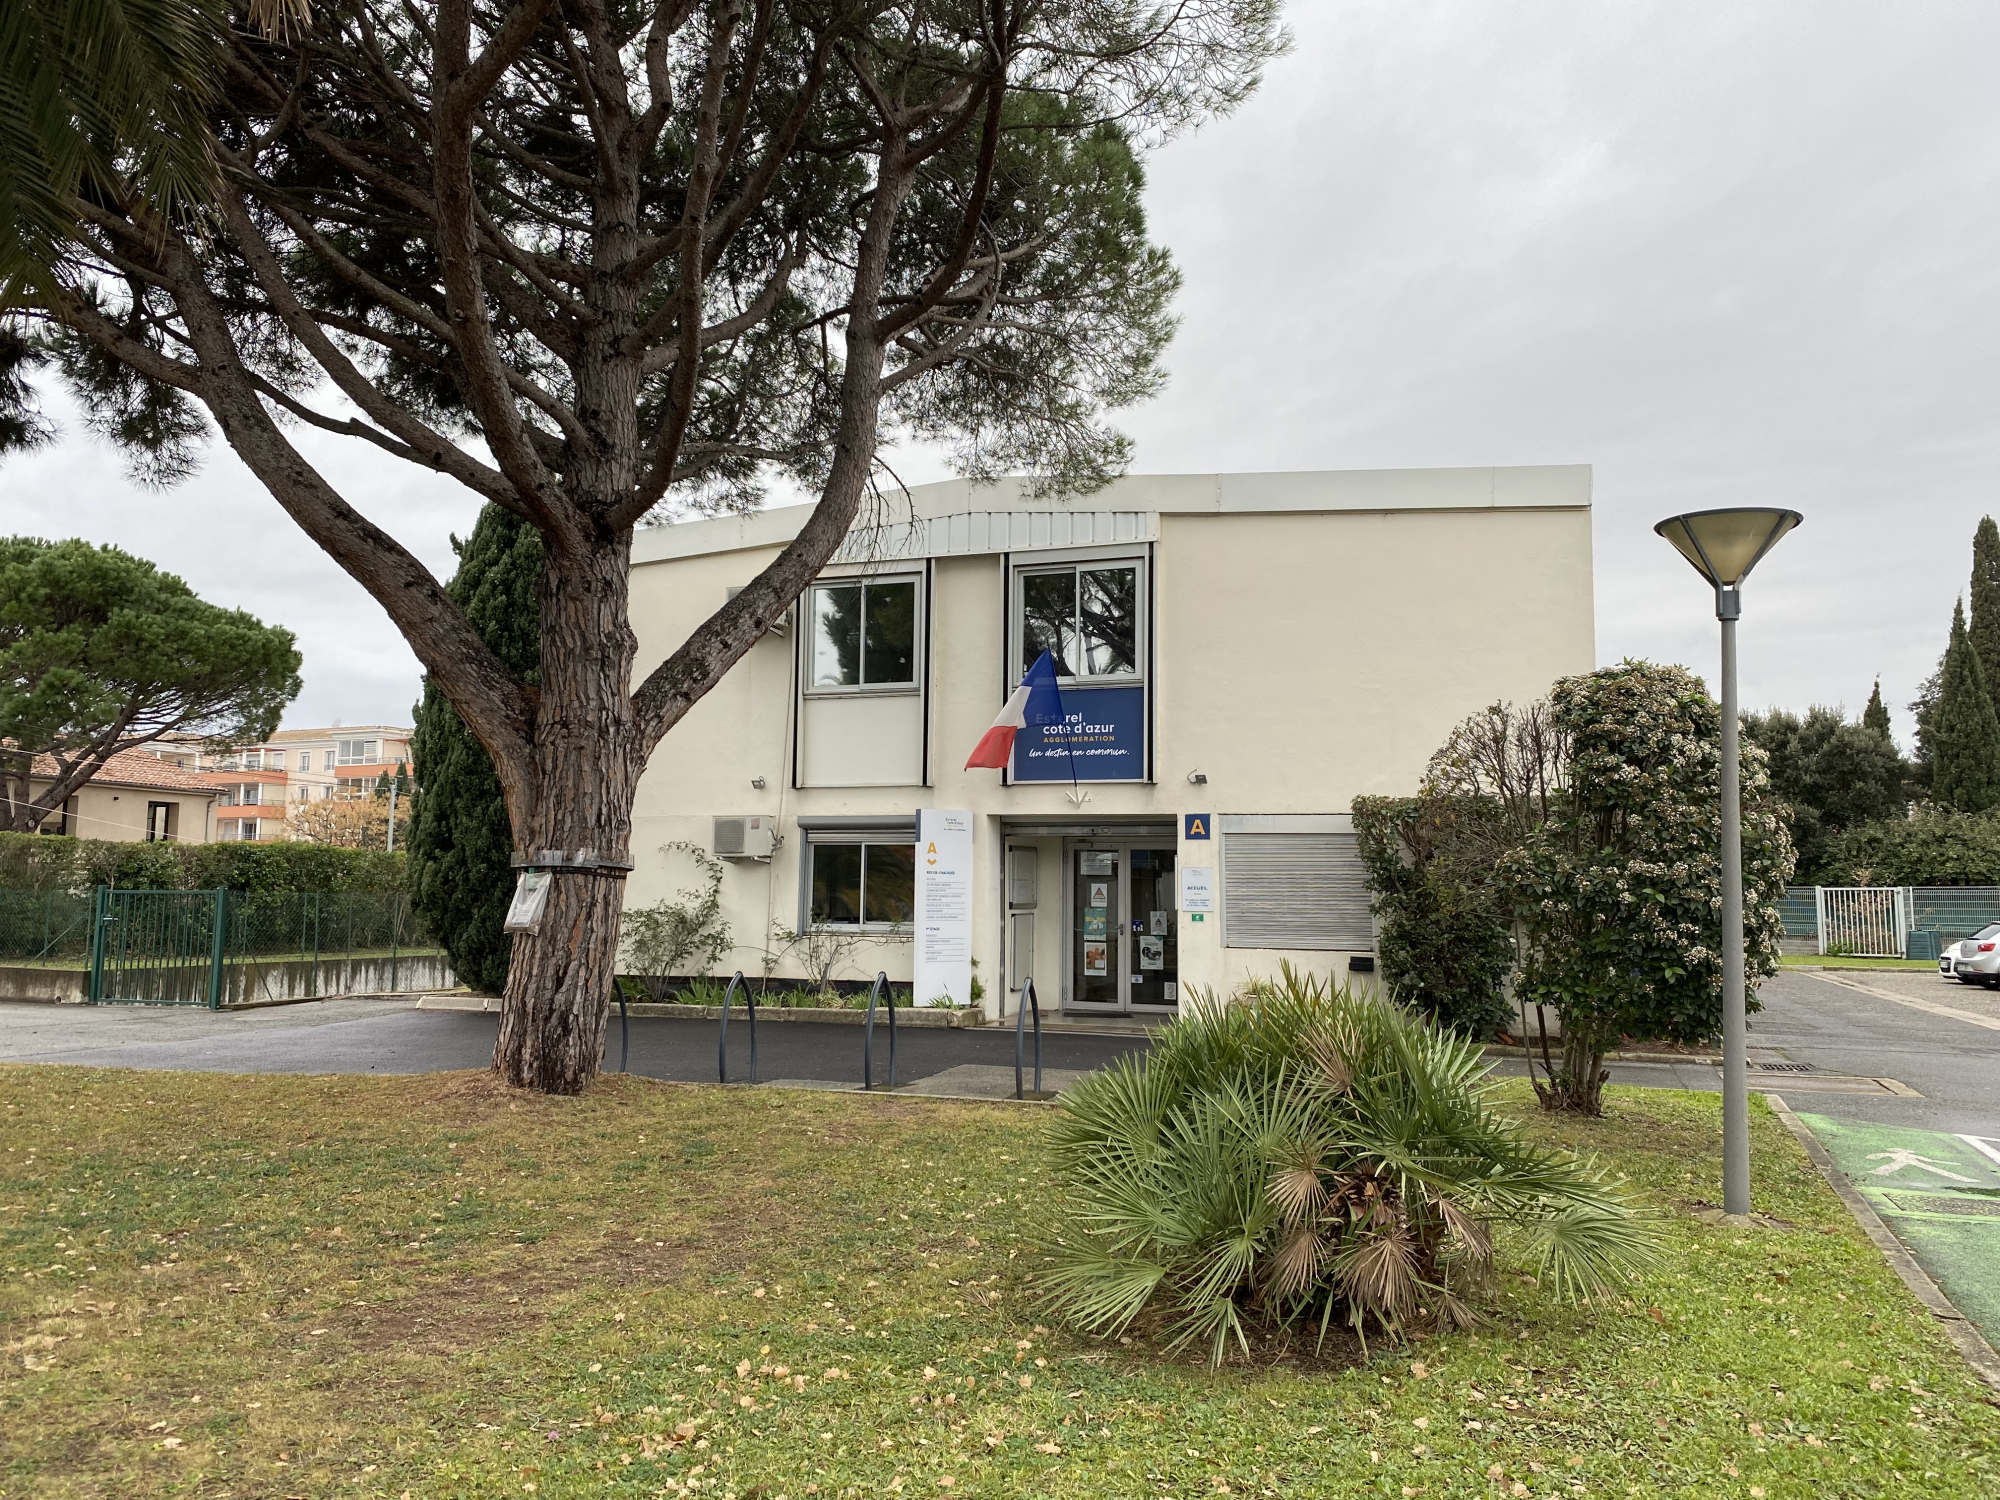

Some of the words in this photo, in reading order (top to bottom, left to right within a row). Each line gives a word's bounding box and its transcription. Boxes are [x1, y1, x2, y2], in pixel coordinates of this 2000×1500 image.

[1074, 722, 1115, 734] d'azur
[1044, 748, 1070, 758] destin
[1190, 819, 1205, 834] A
[927, 842, 937, 854] A
